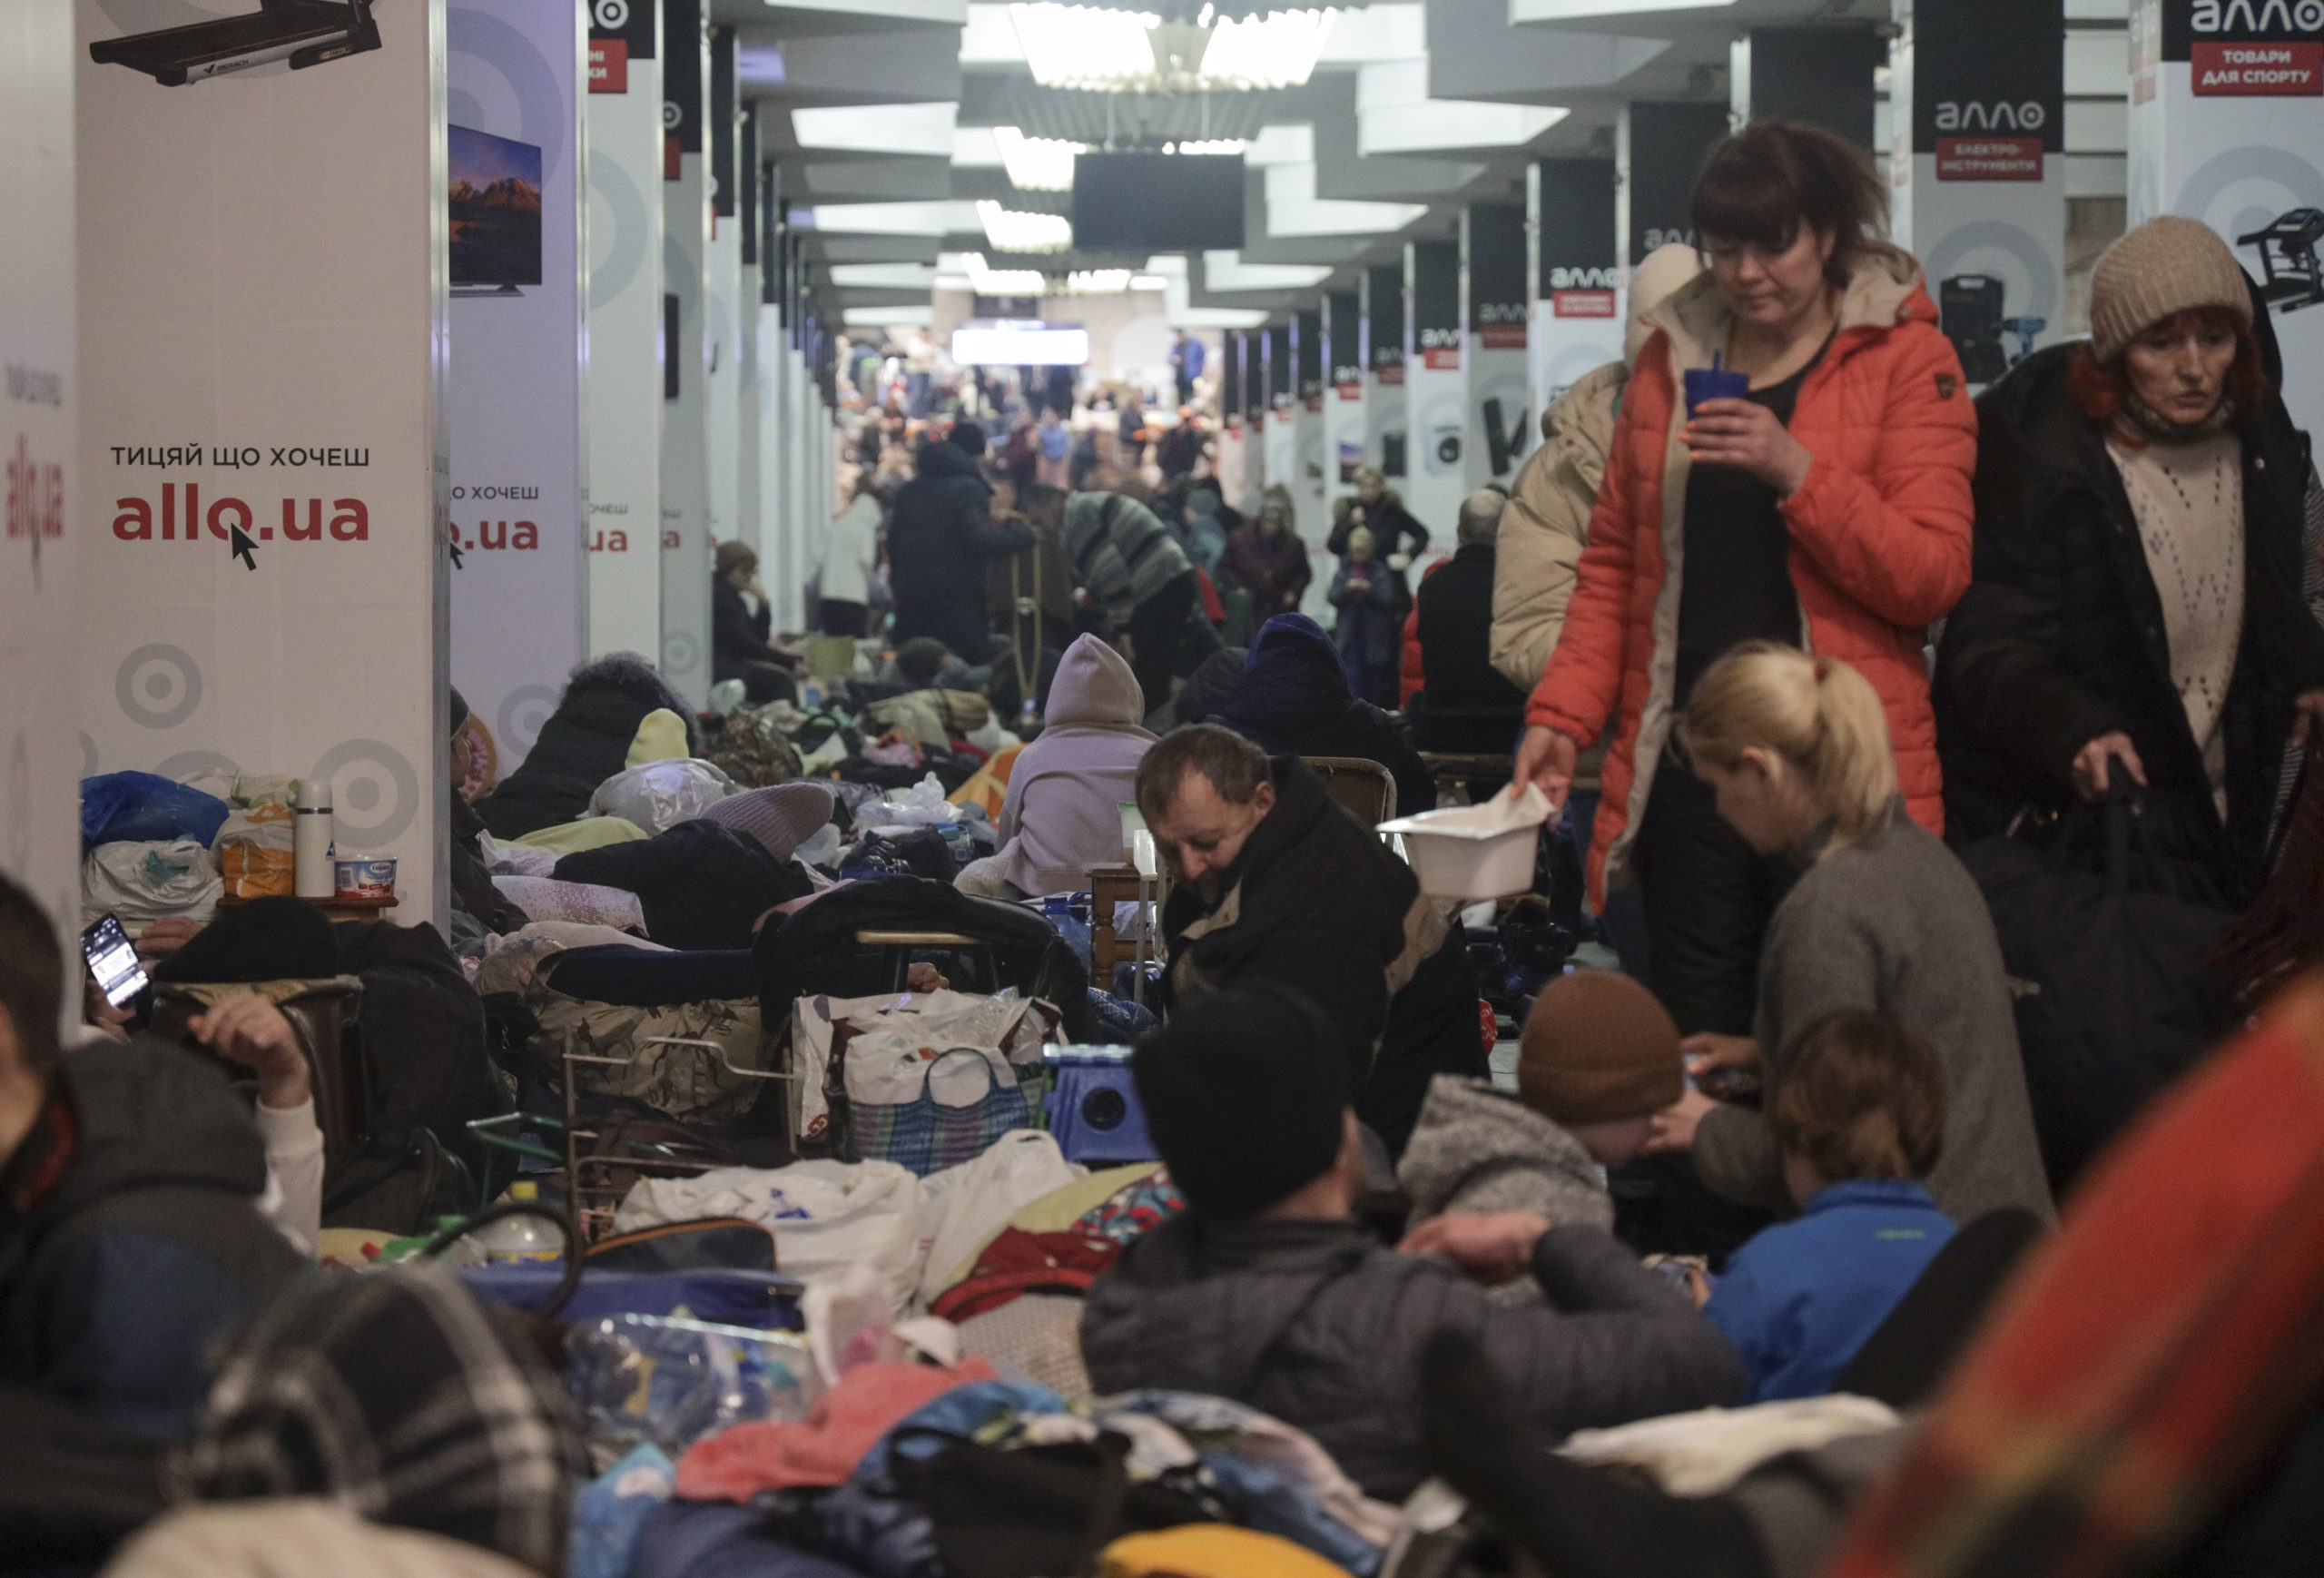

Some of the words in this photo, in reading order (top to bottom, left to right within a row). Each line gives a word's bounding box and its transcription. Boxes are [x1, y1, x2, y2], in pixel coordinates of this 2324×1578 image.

[2223, 51, 2291, 64] ТОВАРИ
[2201, 70, 2239, 85] ДЛЯ
[2242, 70, 2310, 84] СПОРТУ
[111, 442, 202, 469] ТИЦЯЙ
[213, 448, 261, 469] ЩО
[270, 448, 369, 467] ХОЧЕШ
[450, 486, 466, 499] О
[471, 486, 538, 499] ХОЧЕШ
[112, 483, 369, 541] allo.ua
[590, 504, 628, 515] ОЧЕШ
